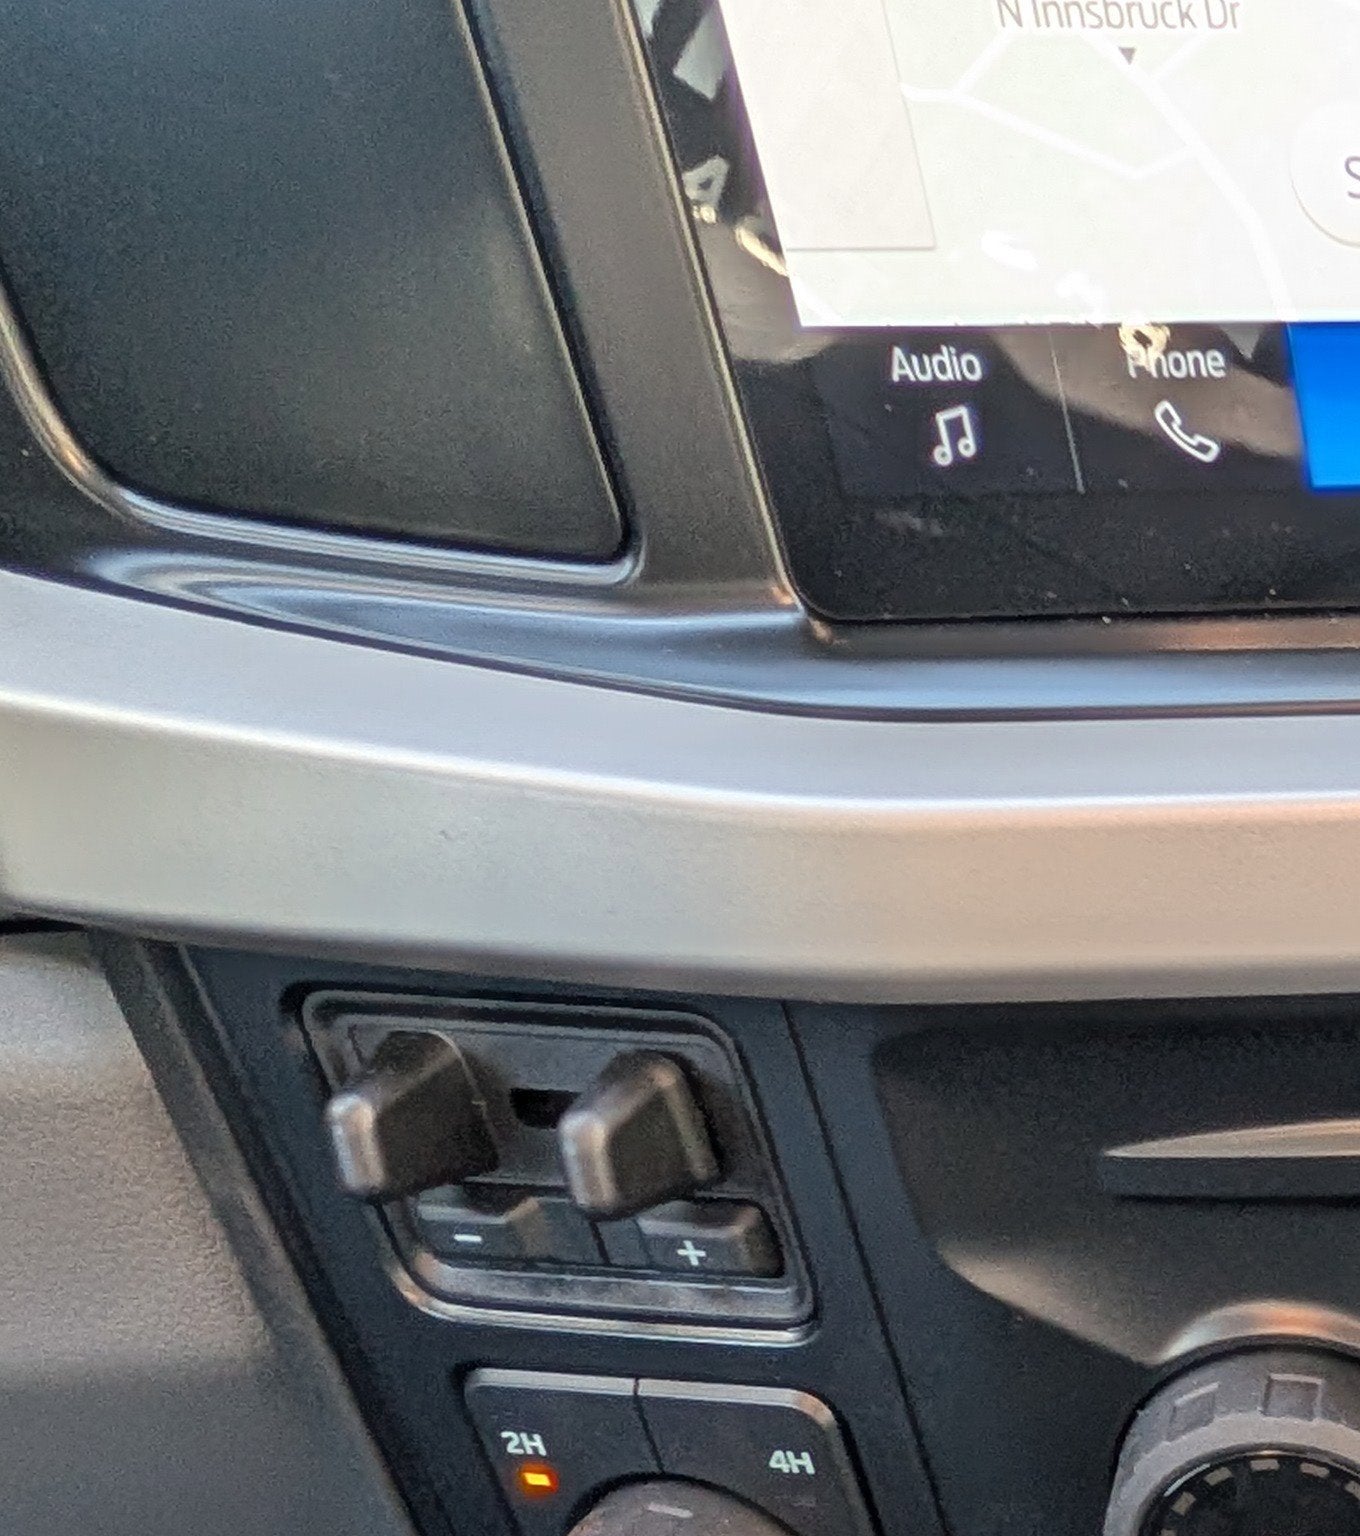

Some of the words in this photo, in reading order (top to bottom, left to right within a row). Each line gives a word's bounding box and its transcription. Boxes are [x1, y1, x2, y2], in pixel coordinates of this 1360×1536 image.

[998, 0, 1024, 29] N
[1030, 0, 1198, 30] Innsbruck
[890, 346, 983, 384] Audio
[500, 1430, 547, 1457] 2H
[767, 1447, 817, 1477] 4H
